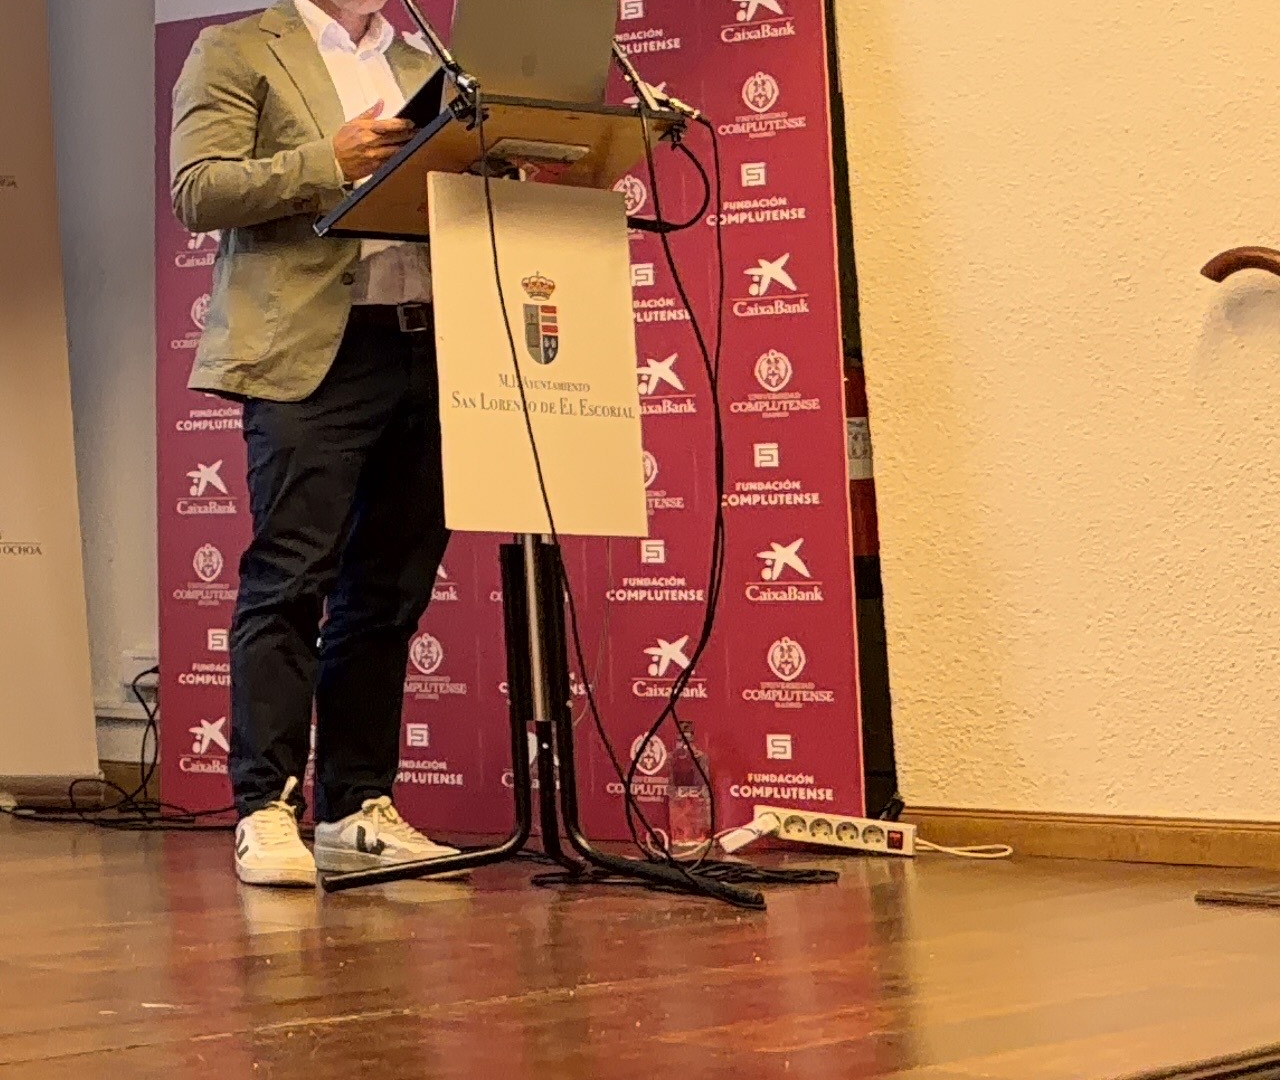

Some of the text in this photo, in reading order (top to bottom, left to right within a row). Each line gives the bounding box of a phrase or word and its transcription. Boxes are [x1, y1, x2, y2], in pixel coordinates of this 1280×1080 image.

[614, 28, 663, 42] NDACIÓN
[721, 23, 795, 43] CaixaBank
[623, 38, 681, 55] PLUTENSE
[718, 117, 806, 135] COMPLUTENSE
[723, 197, 787, 209] FUNDACIÓN
[706, 208, 805, 226] COMPLUTENSE
[174, 254, 215, 268] CaixaB
[634, 297, 675, 309] DACIÓN
[733, 299, 809, 317] CaixaBank
[481, 393, 537, 412] LORENO
[580, 398, 635, 419] ESCORIAL
[640, 399, 696, 415] ixaBank
[730, 398, 820, 413] COMPLUTENSE
[176, 419, 242, 431] COMPLUTEN
[736, 480, 800, 491] FUNDACIÓN
[176, 500, 236, 514] CaixaBank
[623, 577, 685, 587] FUNDACIÓN
[606, 589, 704, 602] COMPLUTENSE
[745, 586, 823, 602] CaixaBank
[192, 663, 230, 673] FUNDACI
[178, 673, 231, 686] COMPLUT
[404, 681, 467, 696] MPLUTENSE
[632, 681, 707, 698] Caixaank
[743, 689, 834, 703] COMPLUTENSE
[179, 758, 228, 774] CaixaBa
[399, 760, 446, 770] NDACIÓN
[396, 770, 463, 786] MPLUTENSE
[748, 773, 814, 784] FUNDACIÓN
[730, 785, 834, 801] COMPLUTENSE
